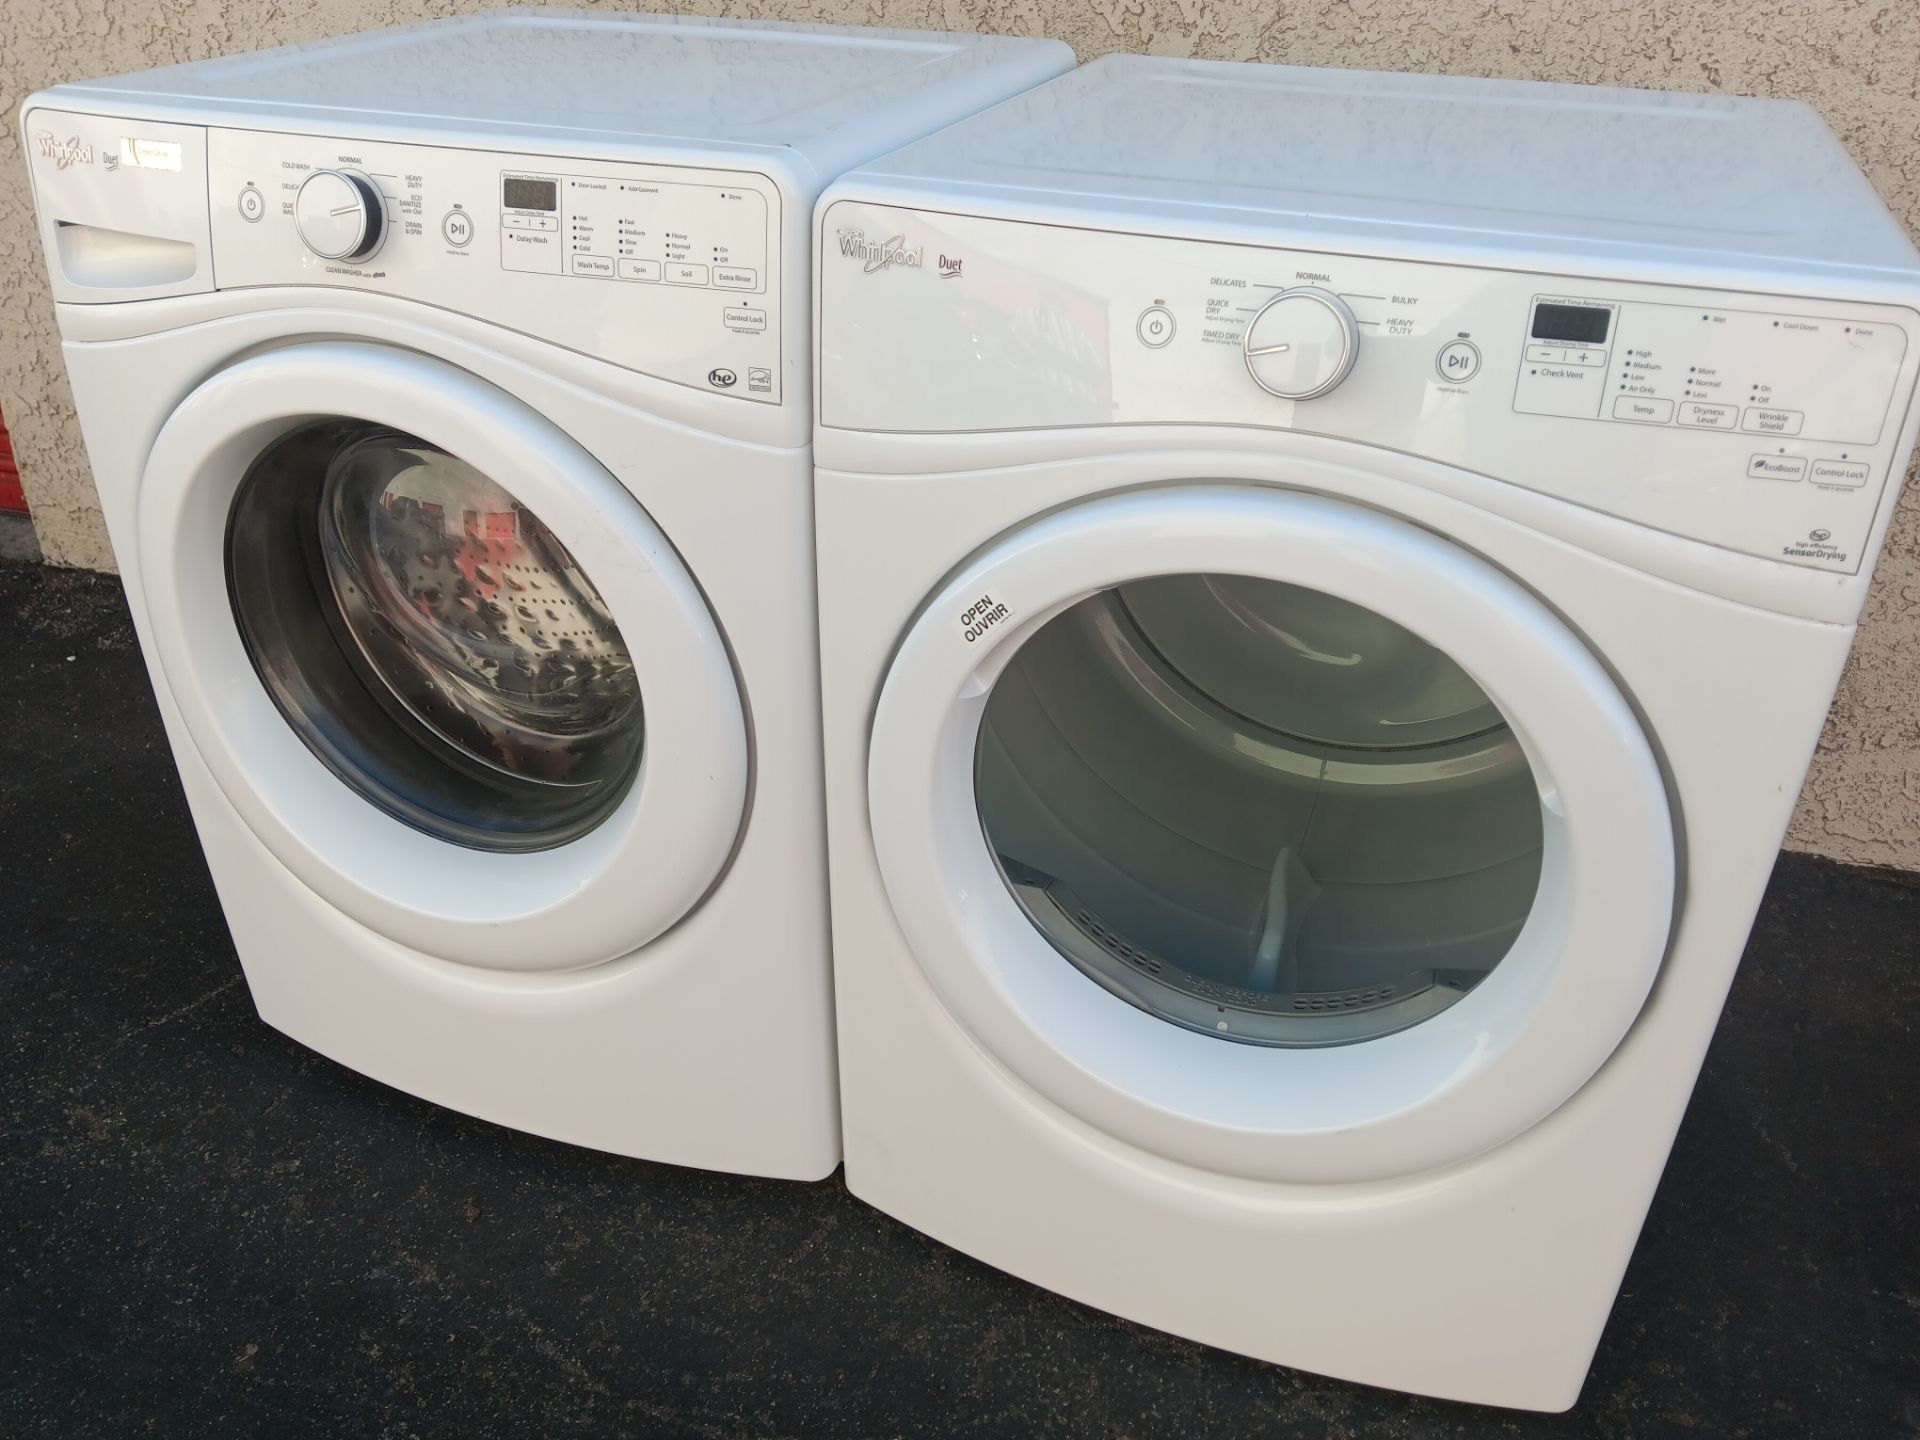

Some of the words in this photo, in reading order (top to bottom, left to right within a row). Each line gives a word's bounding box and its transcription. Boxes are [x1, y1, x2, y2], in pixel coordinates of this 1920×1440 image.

[38, 134, 94, 167] Whirlpool
[103, 152, 119, 164] Duet
[339, 156, 362, 164] NORMAL
[400, 200, 422, 208] SANITIZE
[517, 235, 531, 244] Delay
[533, 236, 547, 244] Wash
[672, 232, 687, 240] Heavy
[838, 234, 924, 271] Whirlpool
[938, 254, 962, 271] Duet
[326, 266, 341, 274] CLEAN
[342, 268, 362, 276] WASHER
[593, 263, 609, 272] Temp
[633, 266, 646, 274] Spin
[681, 270, 692, 278] Soil
[735, 274, 751, 283] Rinse
[1296, 272, 1331, 282] NORMAL
[1210, 278, 1246, 288] DELICATES
[1207, 299, 1229, 307] QUICK
[1392, 296, 1418, 304] BULKY
[1536, 296, 1566, 304] Estimated
[1583, 300, 1615, 309] Remaining
[1206, 307, 1220, 315] DRY
[726, 314, 748, 322] Control
[1387, 318, 1414, 326] HEAVY
[1203, 330, 1224, 338] TIMED
[1225, 332, 1240, 340] DRY
[1389, 327, 1413, 335] DUTY
[1855, 328, 1873, 336] Done
[1636, 350, 1652, 358] High
[1633, 362, 1662, 370] Medium
[1541, 369, 1565, 377] Check
[1566, 370, 1583, 379] Vent
[1639, 386, 1655, 394] Only
[1758, 396, 1769, 404] Off
[1633, 405, 1654, 415] Temp
[1693, 406, 1725, 418] Dryness
[1697, 416, 1718, 425] Level
[1759, 412, 1789, 422] Wrinkle
[1759, 421, 1784, 430] Shield
[1764, 464, 1800, 473] EcoBoost
[1816, 468, 1845, 477] Control
[1846, 471, 1864, 479] Lock
[1783, 547, 1846, 561] SensorDrying
[961, 595, 993, 626] OPEN
[965, 604, 1008, 642] OUVRIR
